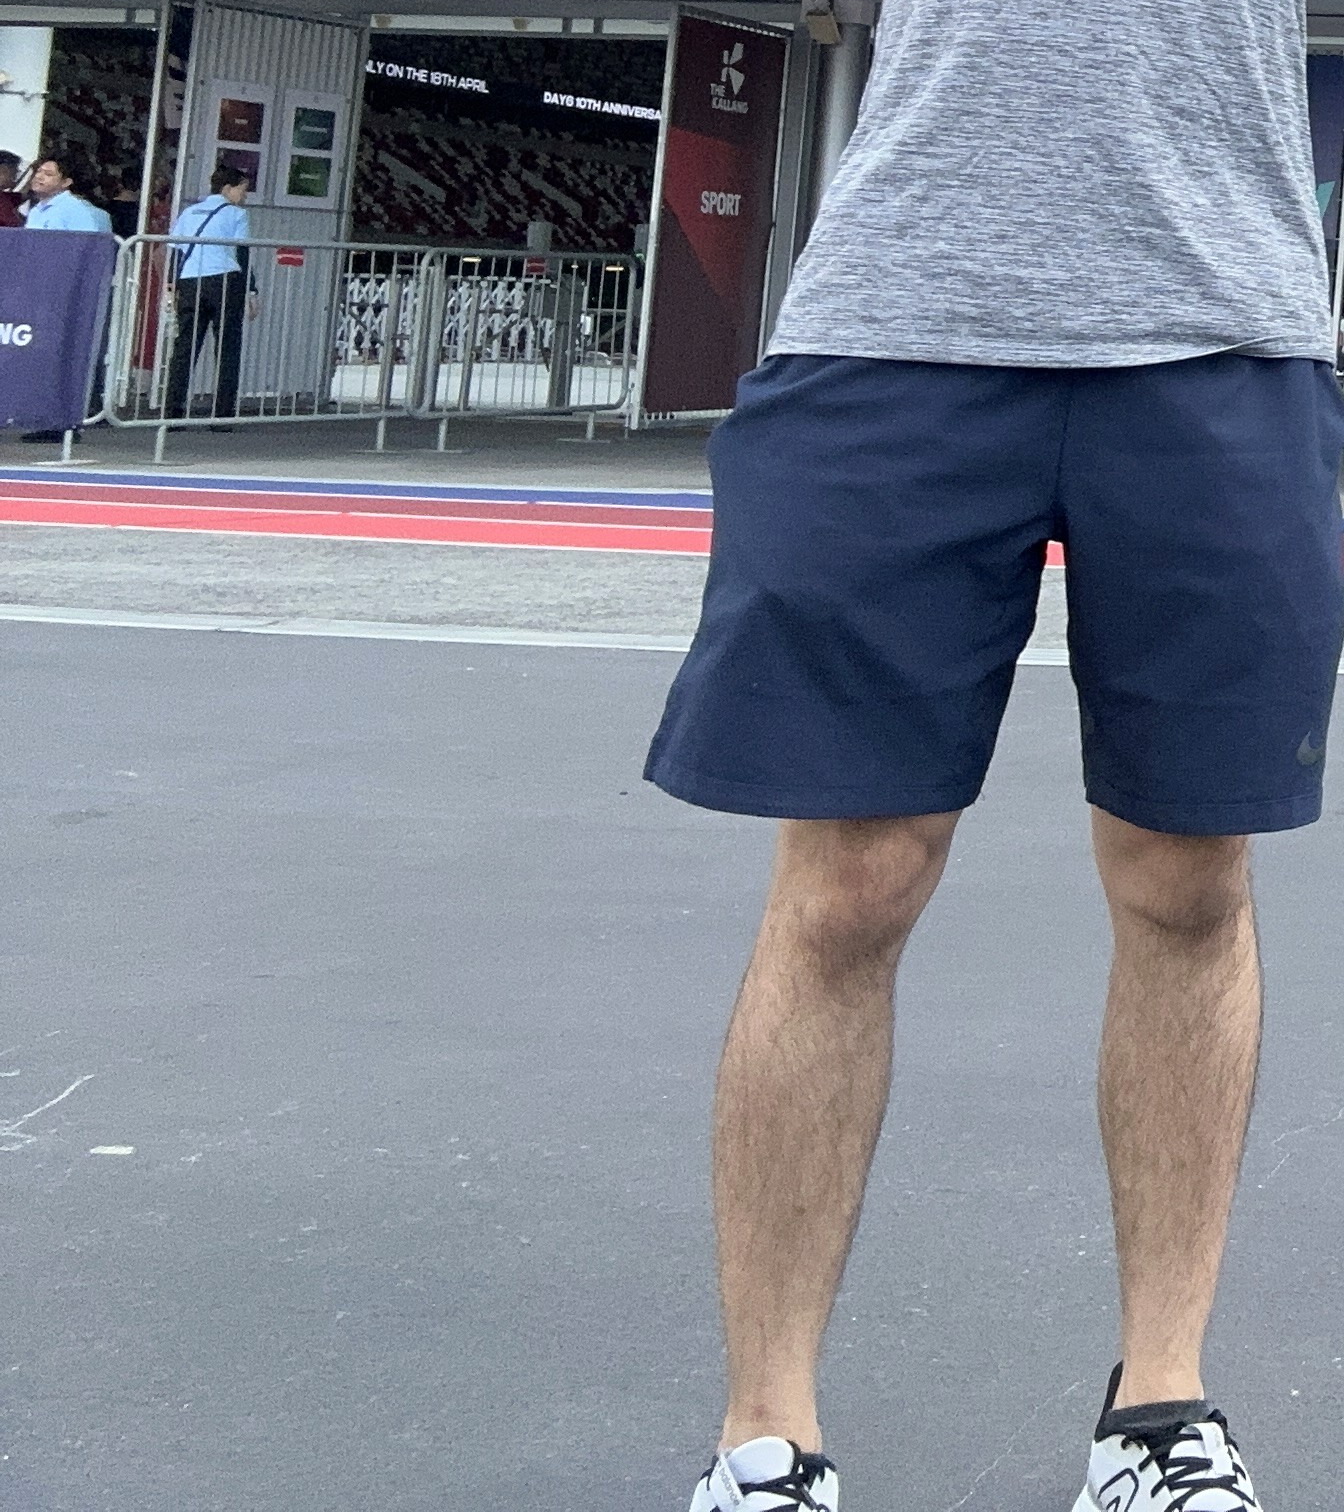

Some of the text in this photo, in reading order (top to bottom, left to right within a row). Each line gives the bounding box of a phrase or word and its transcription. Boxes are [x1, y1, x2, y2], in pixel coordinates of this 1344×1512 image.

[386, 63, 404, 78] ON
[406, 66, 429, 83] THE
[457, 76, 489, 94] APRIL
[701, 190, 741, 216] SPORT
